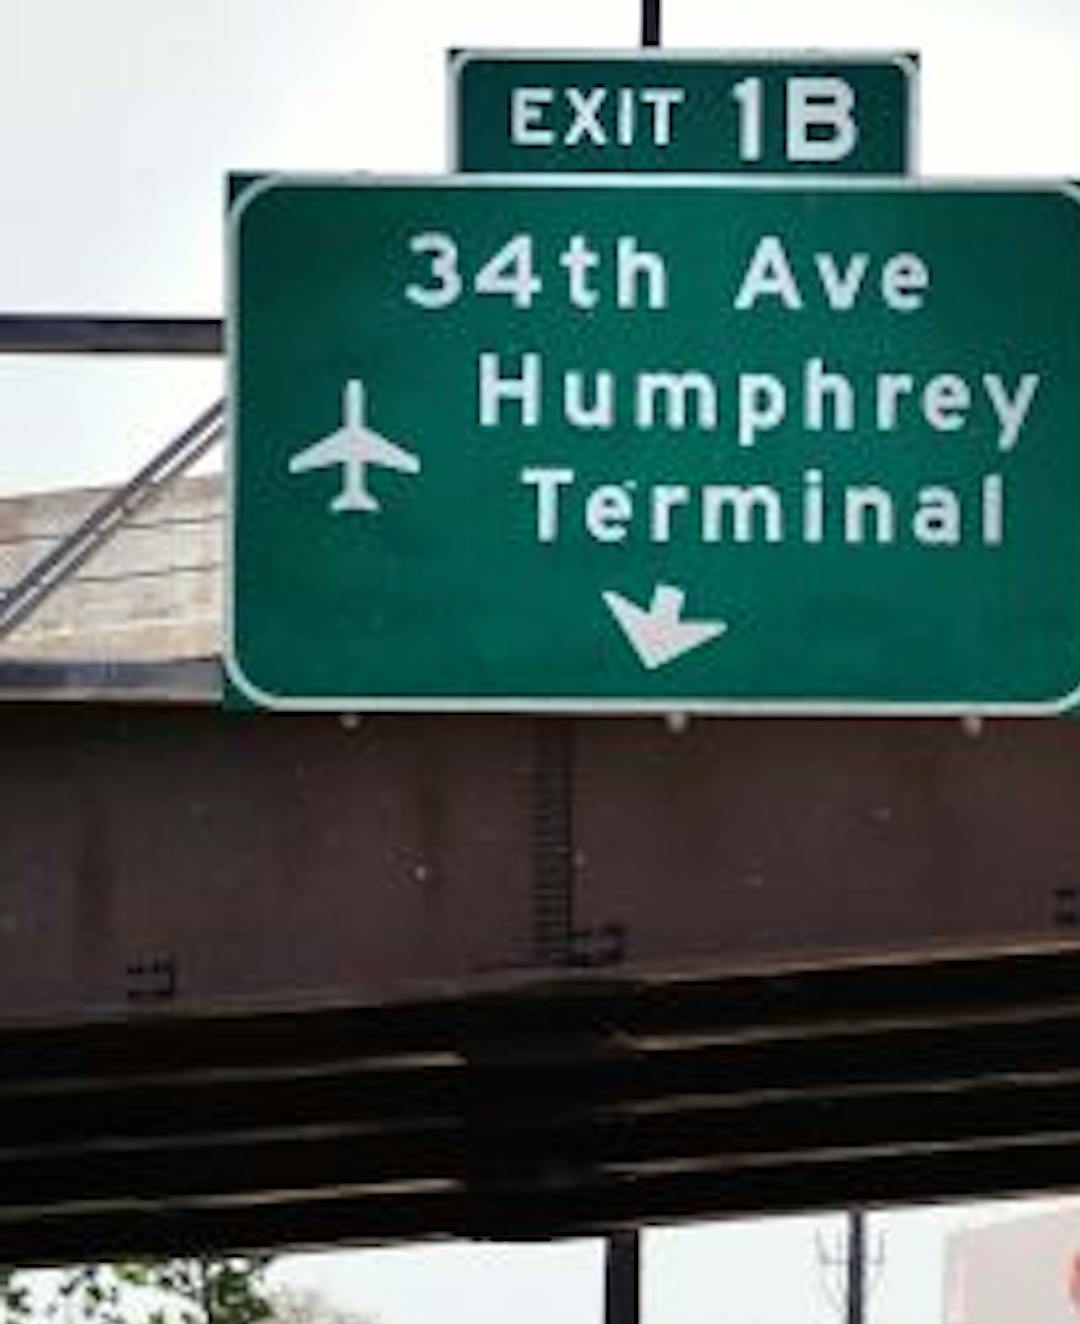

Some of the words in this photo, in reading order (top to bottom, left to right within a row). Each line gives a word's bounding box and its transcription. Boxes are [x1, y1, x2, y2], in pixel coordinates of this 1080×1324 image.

[511, 88, 684, 146] EXIT
[733, 77, 857, 161] 1B
[405, 234, 667, 309] 34th
[733, 236, 930, 309] Ave
[478, 352, 1039, 449] Humphrey
[522, 468, 1003, 544] Terminal
